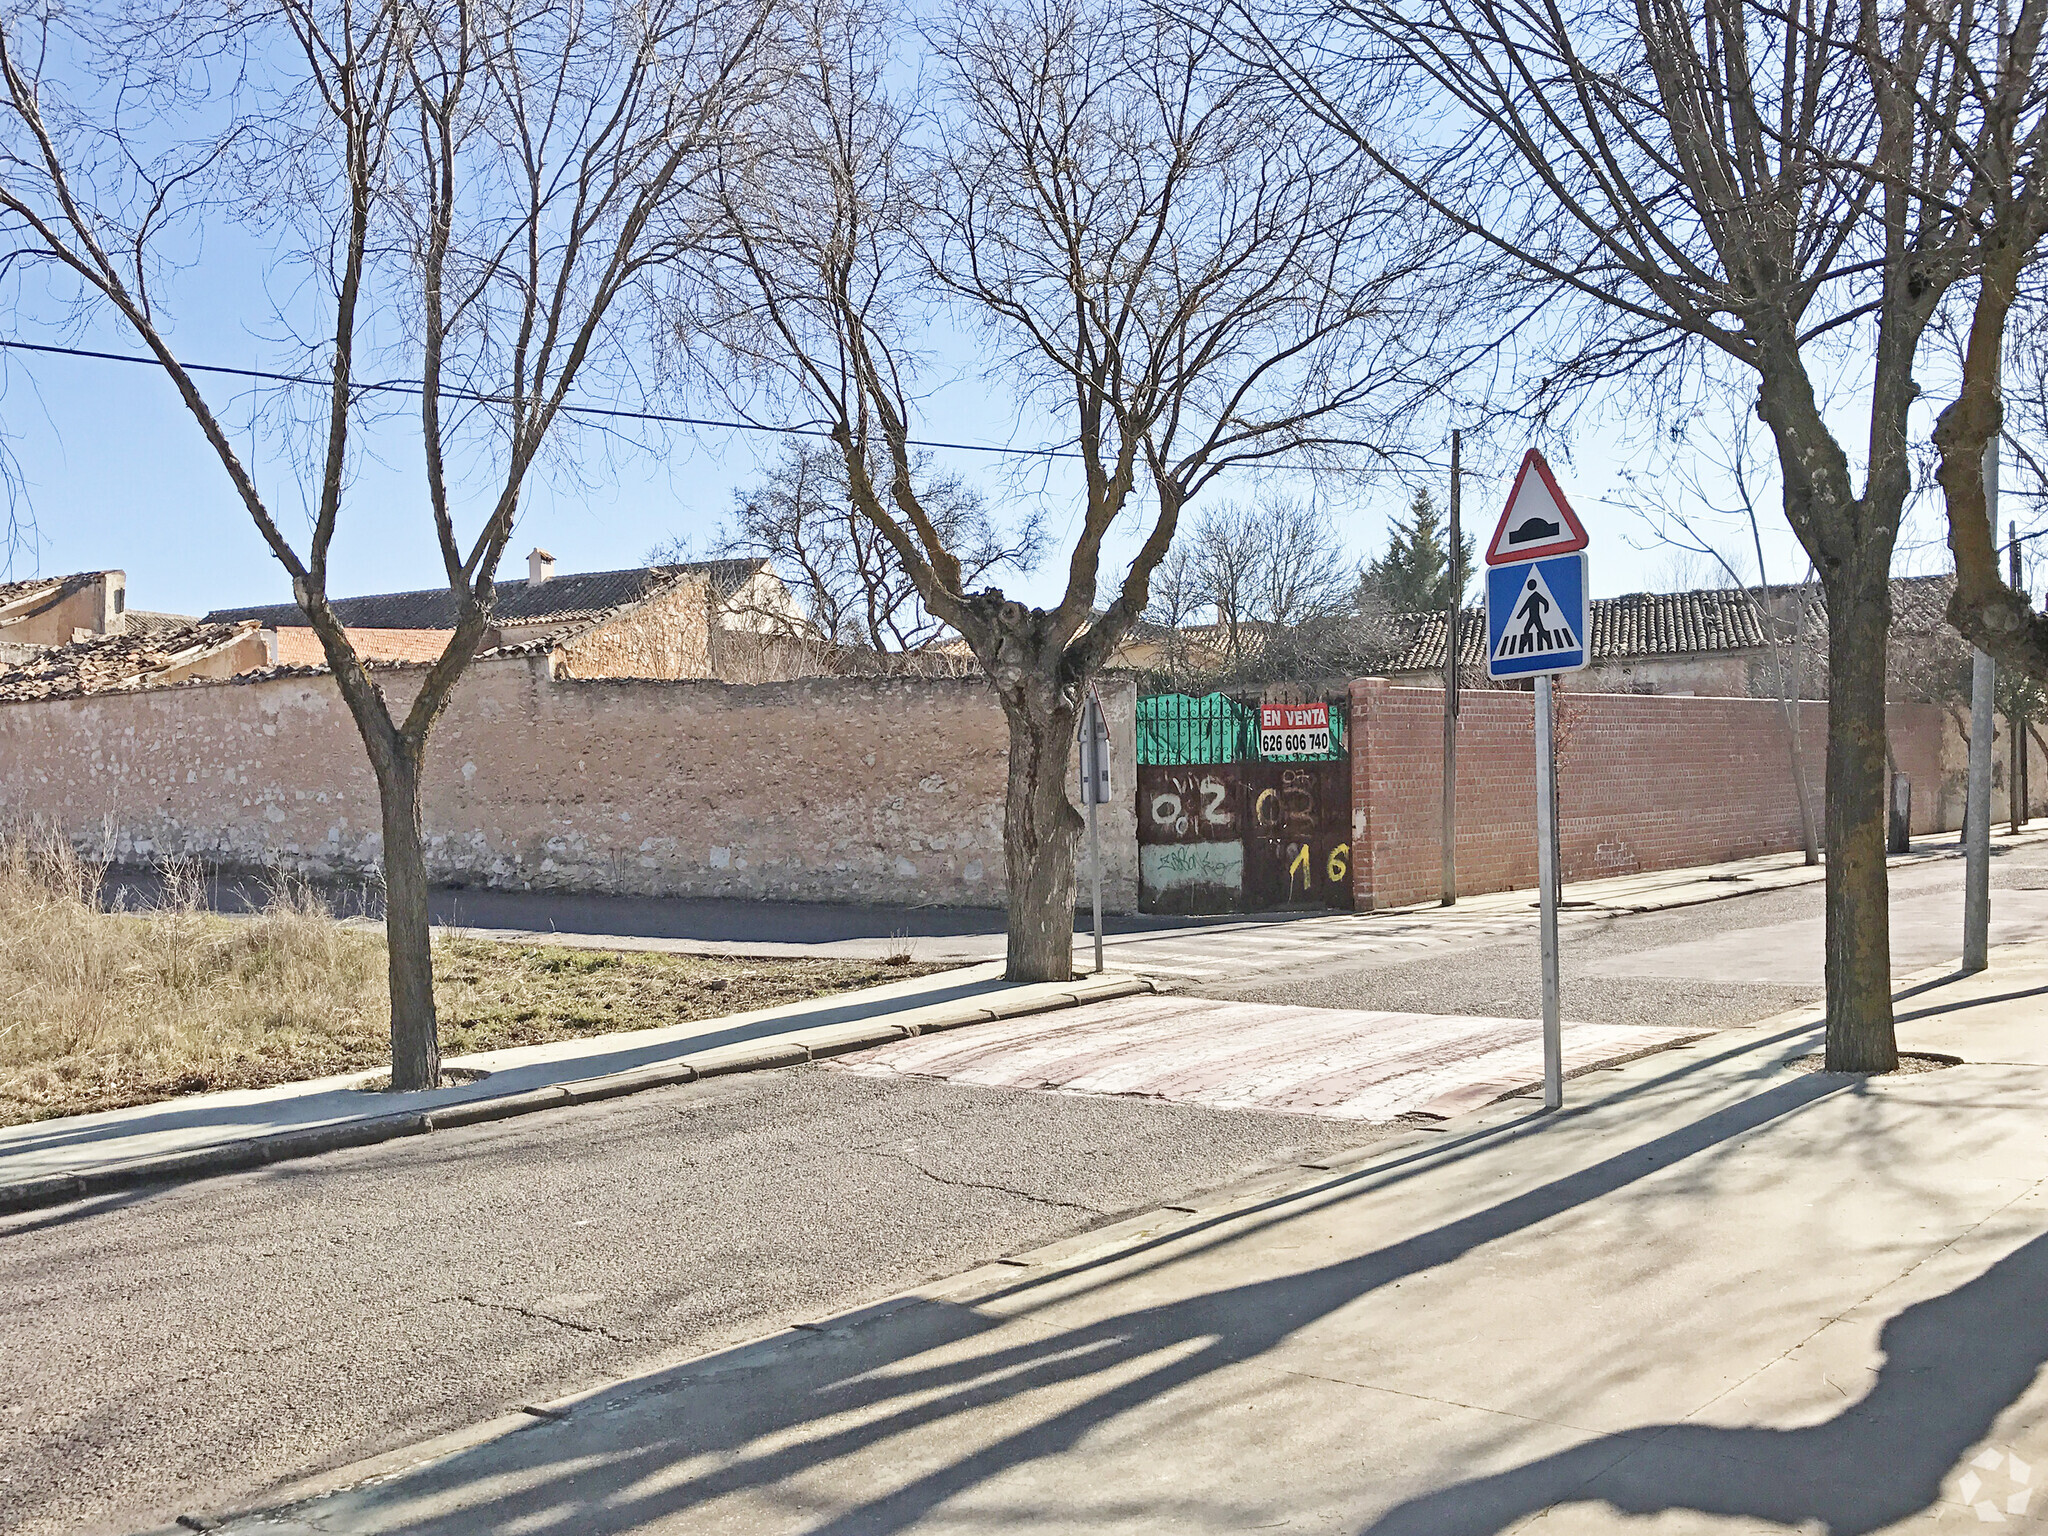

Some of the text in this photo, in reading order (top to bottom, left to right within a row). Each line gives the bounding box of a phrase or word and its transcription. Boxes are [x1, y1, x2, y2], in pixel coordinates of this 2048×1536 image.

[1263, 708, 1327, 726] EN VENTA
[1263, 733, 1328, 751] 626 606 740
